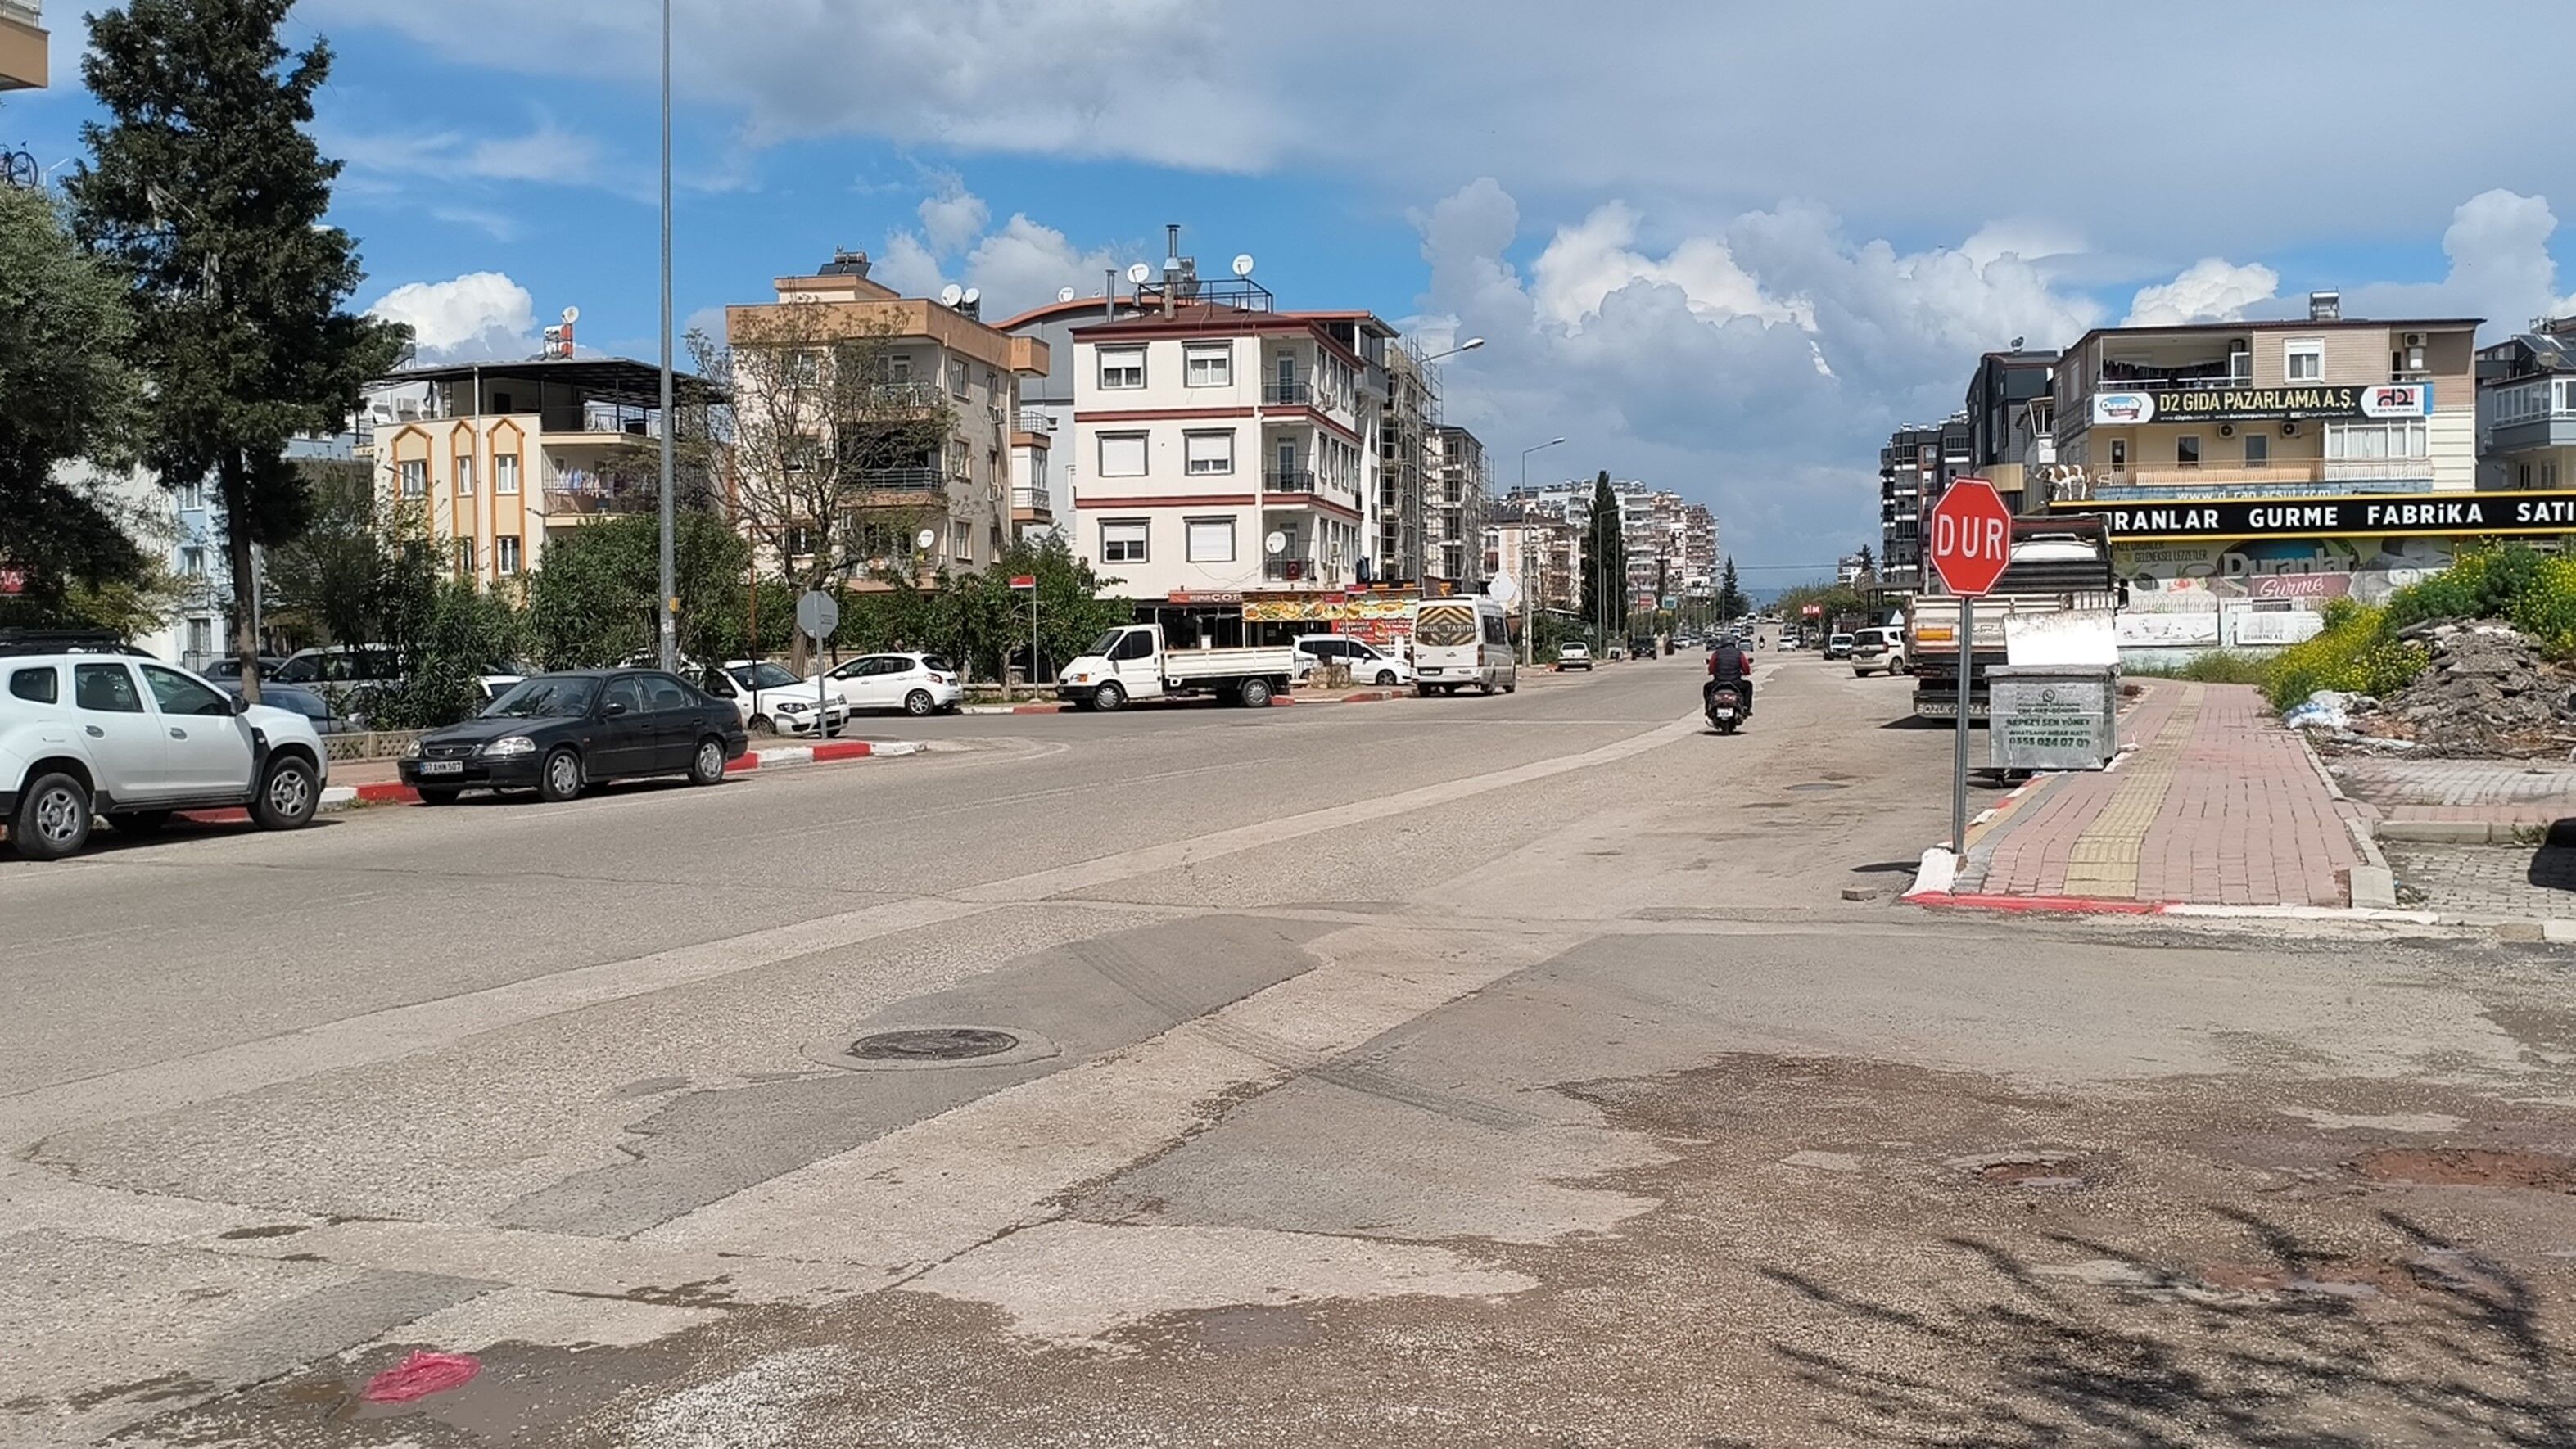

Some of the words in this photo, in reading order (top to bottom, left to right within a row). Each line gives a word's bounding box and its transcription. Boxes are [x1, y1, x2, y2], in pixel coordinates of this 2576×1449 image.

[2159, 394, 2179, 412] D2
[2183, 392, 2221, 411] GIDA
[2224, 389, 2321, 410] PAZARLAMA
[2324, 389, 2356, 409] A.Ş.
[2248, 506, 2339, 528] GURME
[1937, 514, 2004, 560] DUR
[2223, 548, 2355, 578] Duranlar
[2259, 578, 2325, 598] Gurme
[1446, 625, 1474, 633] TAŞITI
[1917, 703, 1953, 714] BOZUK
[2060, 738, 2074, 747] 07
